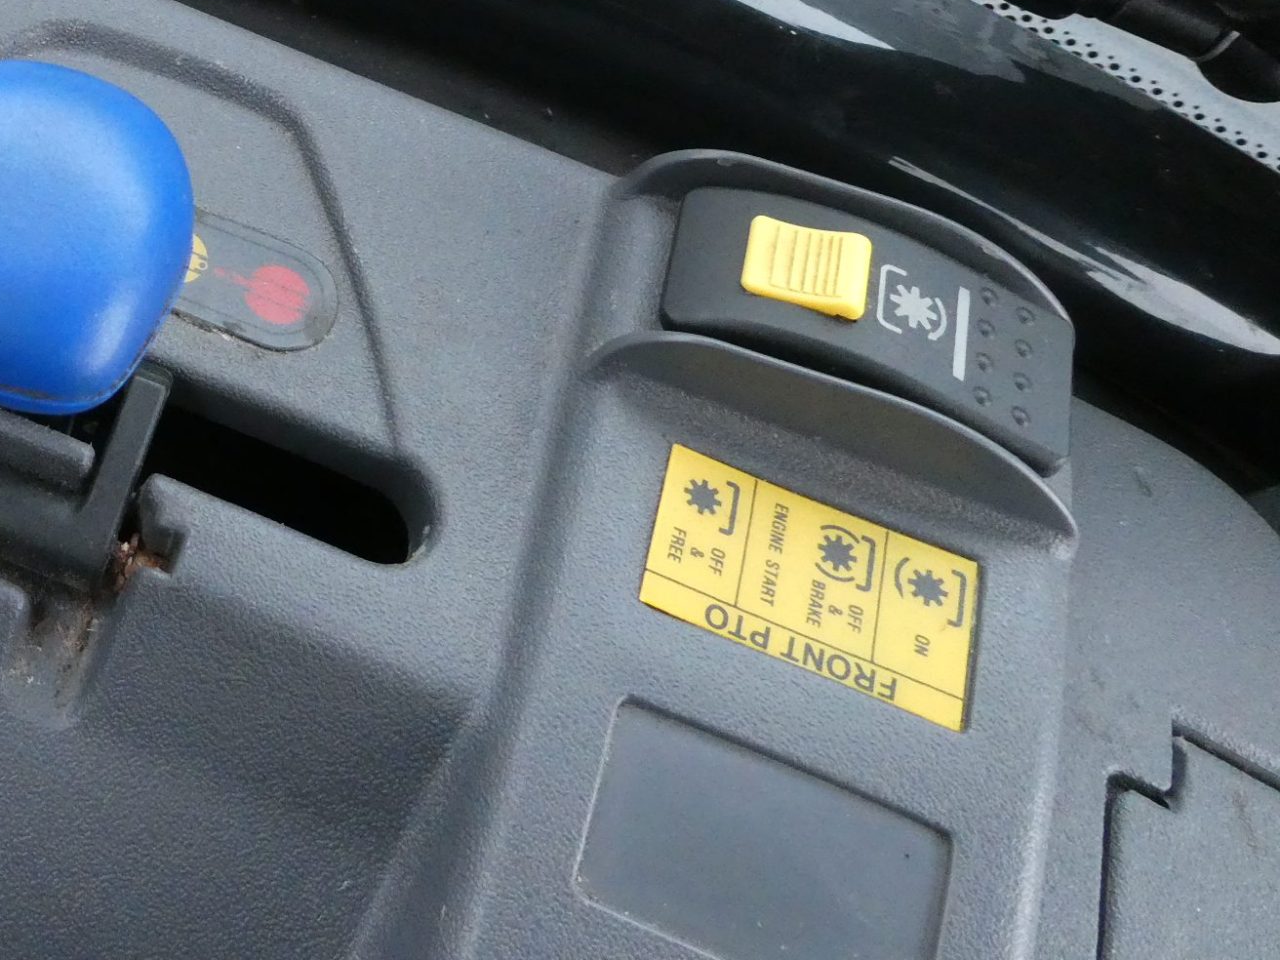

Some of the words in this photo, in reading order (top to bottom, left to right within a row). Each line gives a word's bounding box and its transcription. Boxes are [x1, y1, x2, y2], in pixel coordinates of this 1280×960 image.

[667, 526, 687, 563] FREE
[768, 502, 790, 556] ENGINE
[691, 547, 704, 558] &
[710, 547, 726, 576] OFF
[760, 559, 780, 607] START
[806, 580, 826, 626] BRAKE
[828, 605, 842, 617] &
[848, 604, 864, 633] OFF
[704, 604, 771, 650] PTO
[914, 634, 931, 657] ON
[780, 636, 898, 701] FRONT
